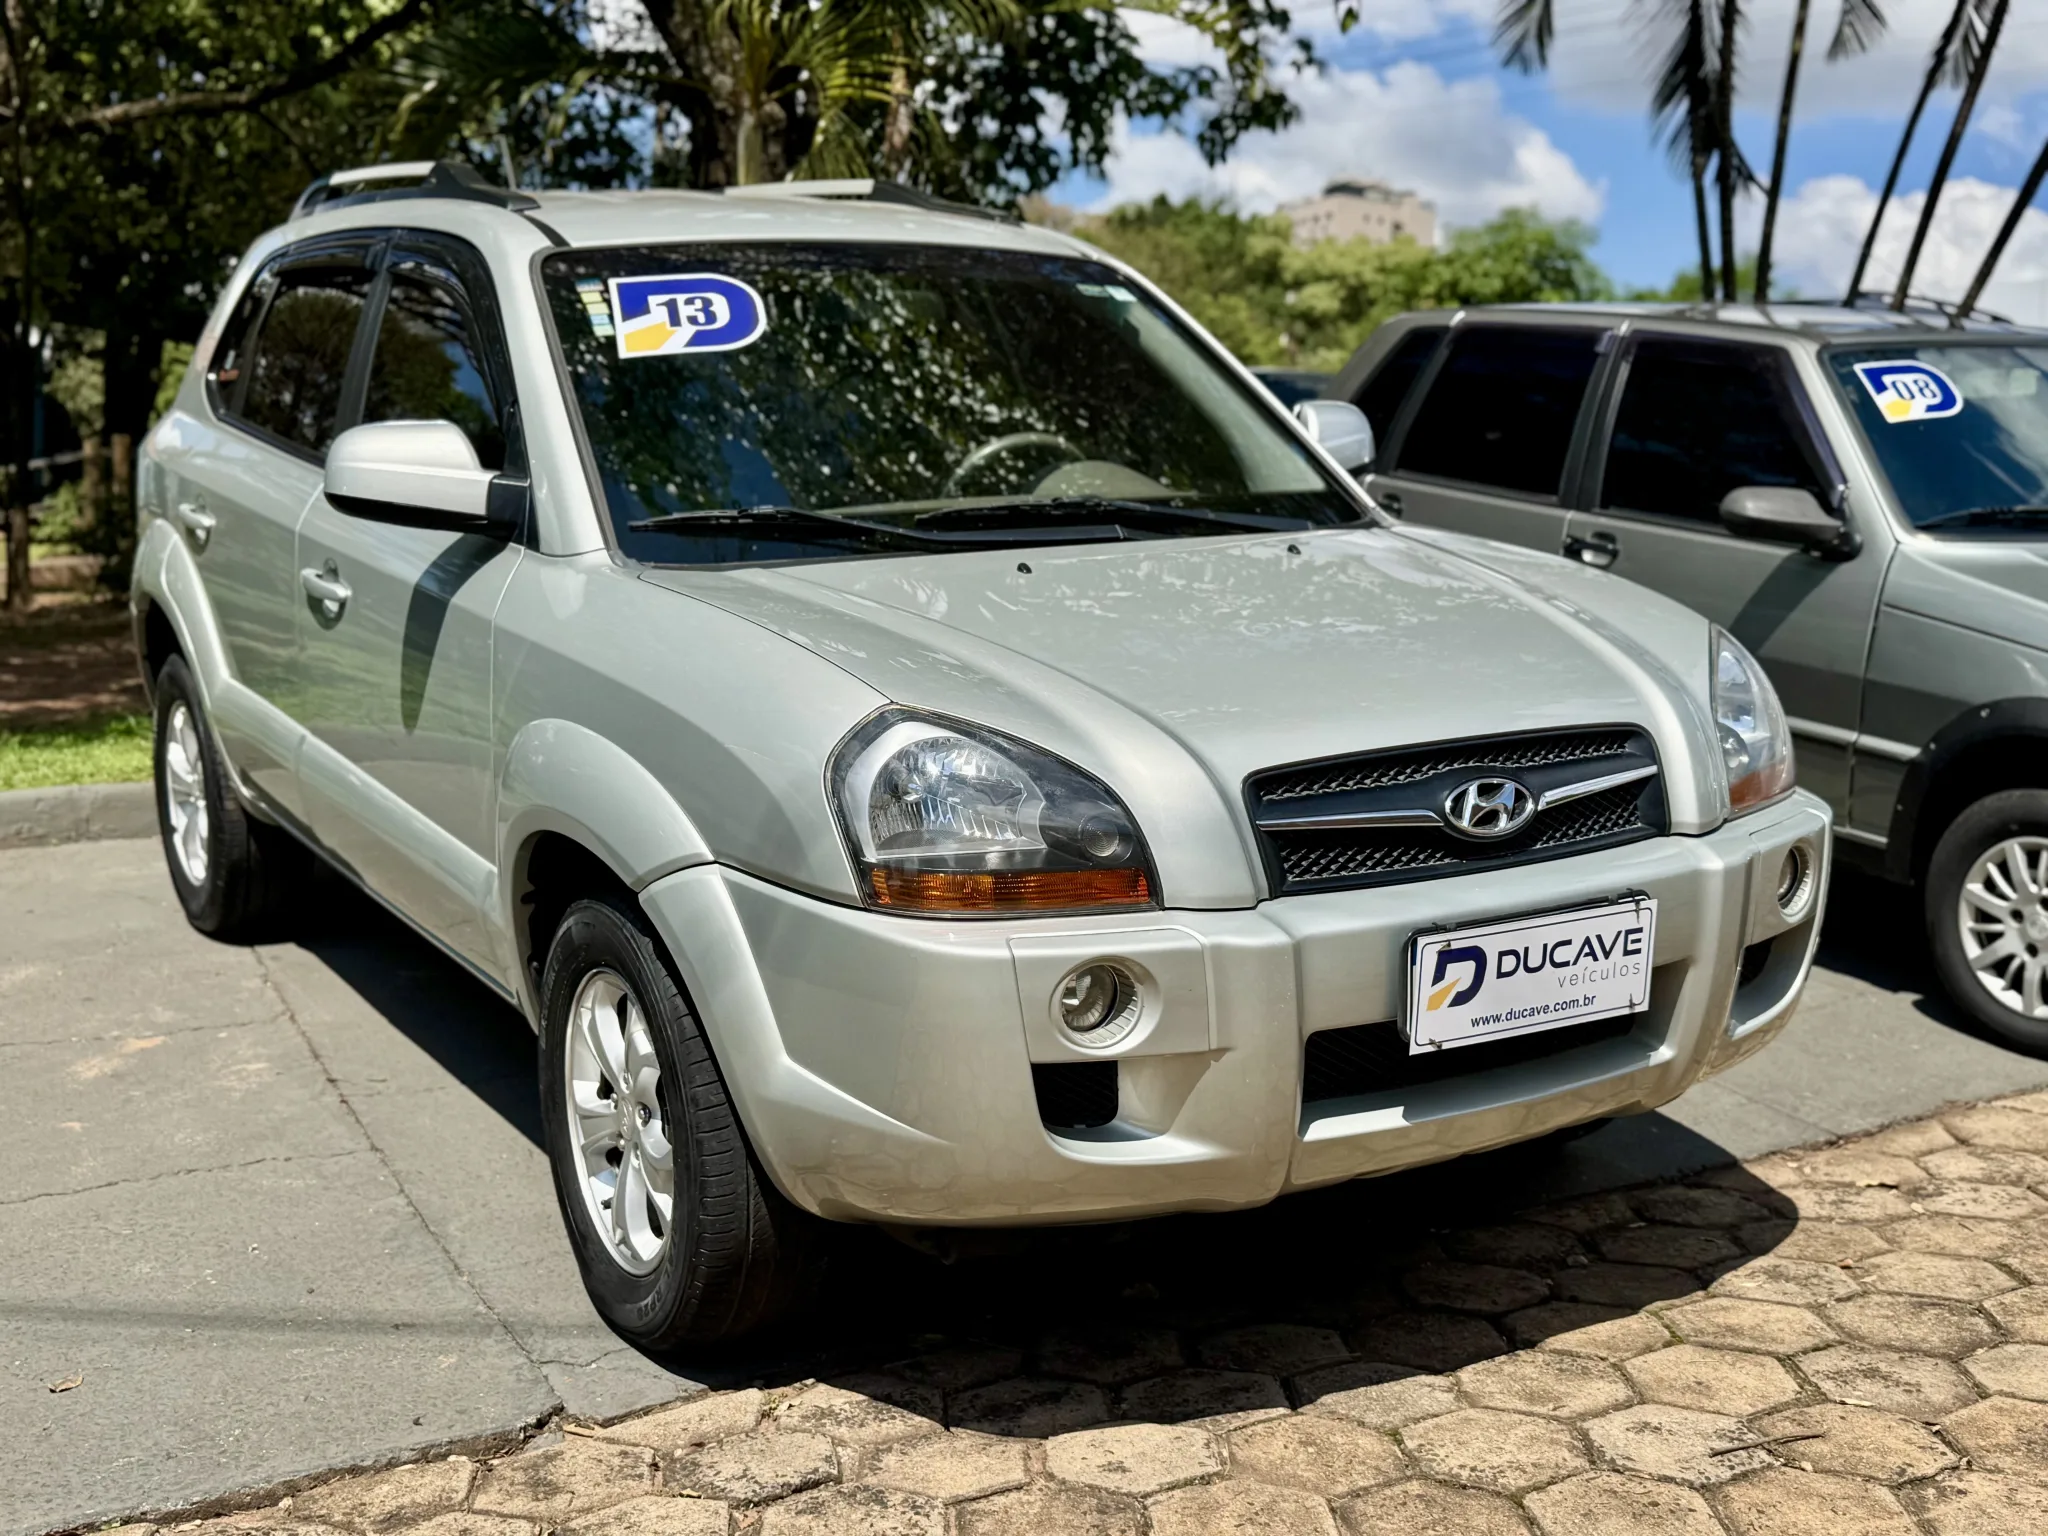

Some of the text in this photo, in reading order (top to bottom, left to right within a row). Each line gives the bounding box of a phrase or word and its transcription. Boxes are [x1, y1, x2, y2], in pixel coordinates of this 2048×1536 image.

[656, 295, 718, 328] 13
[1891, 379, 1937, 401] 08
[1496, 926, 1644, 980] DUCAVE
[1557, 961, 1641, 989] veículos
[1470, 993, 1597, 1028] www.ducave.com.br
